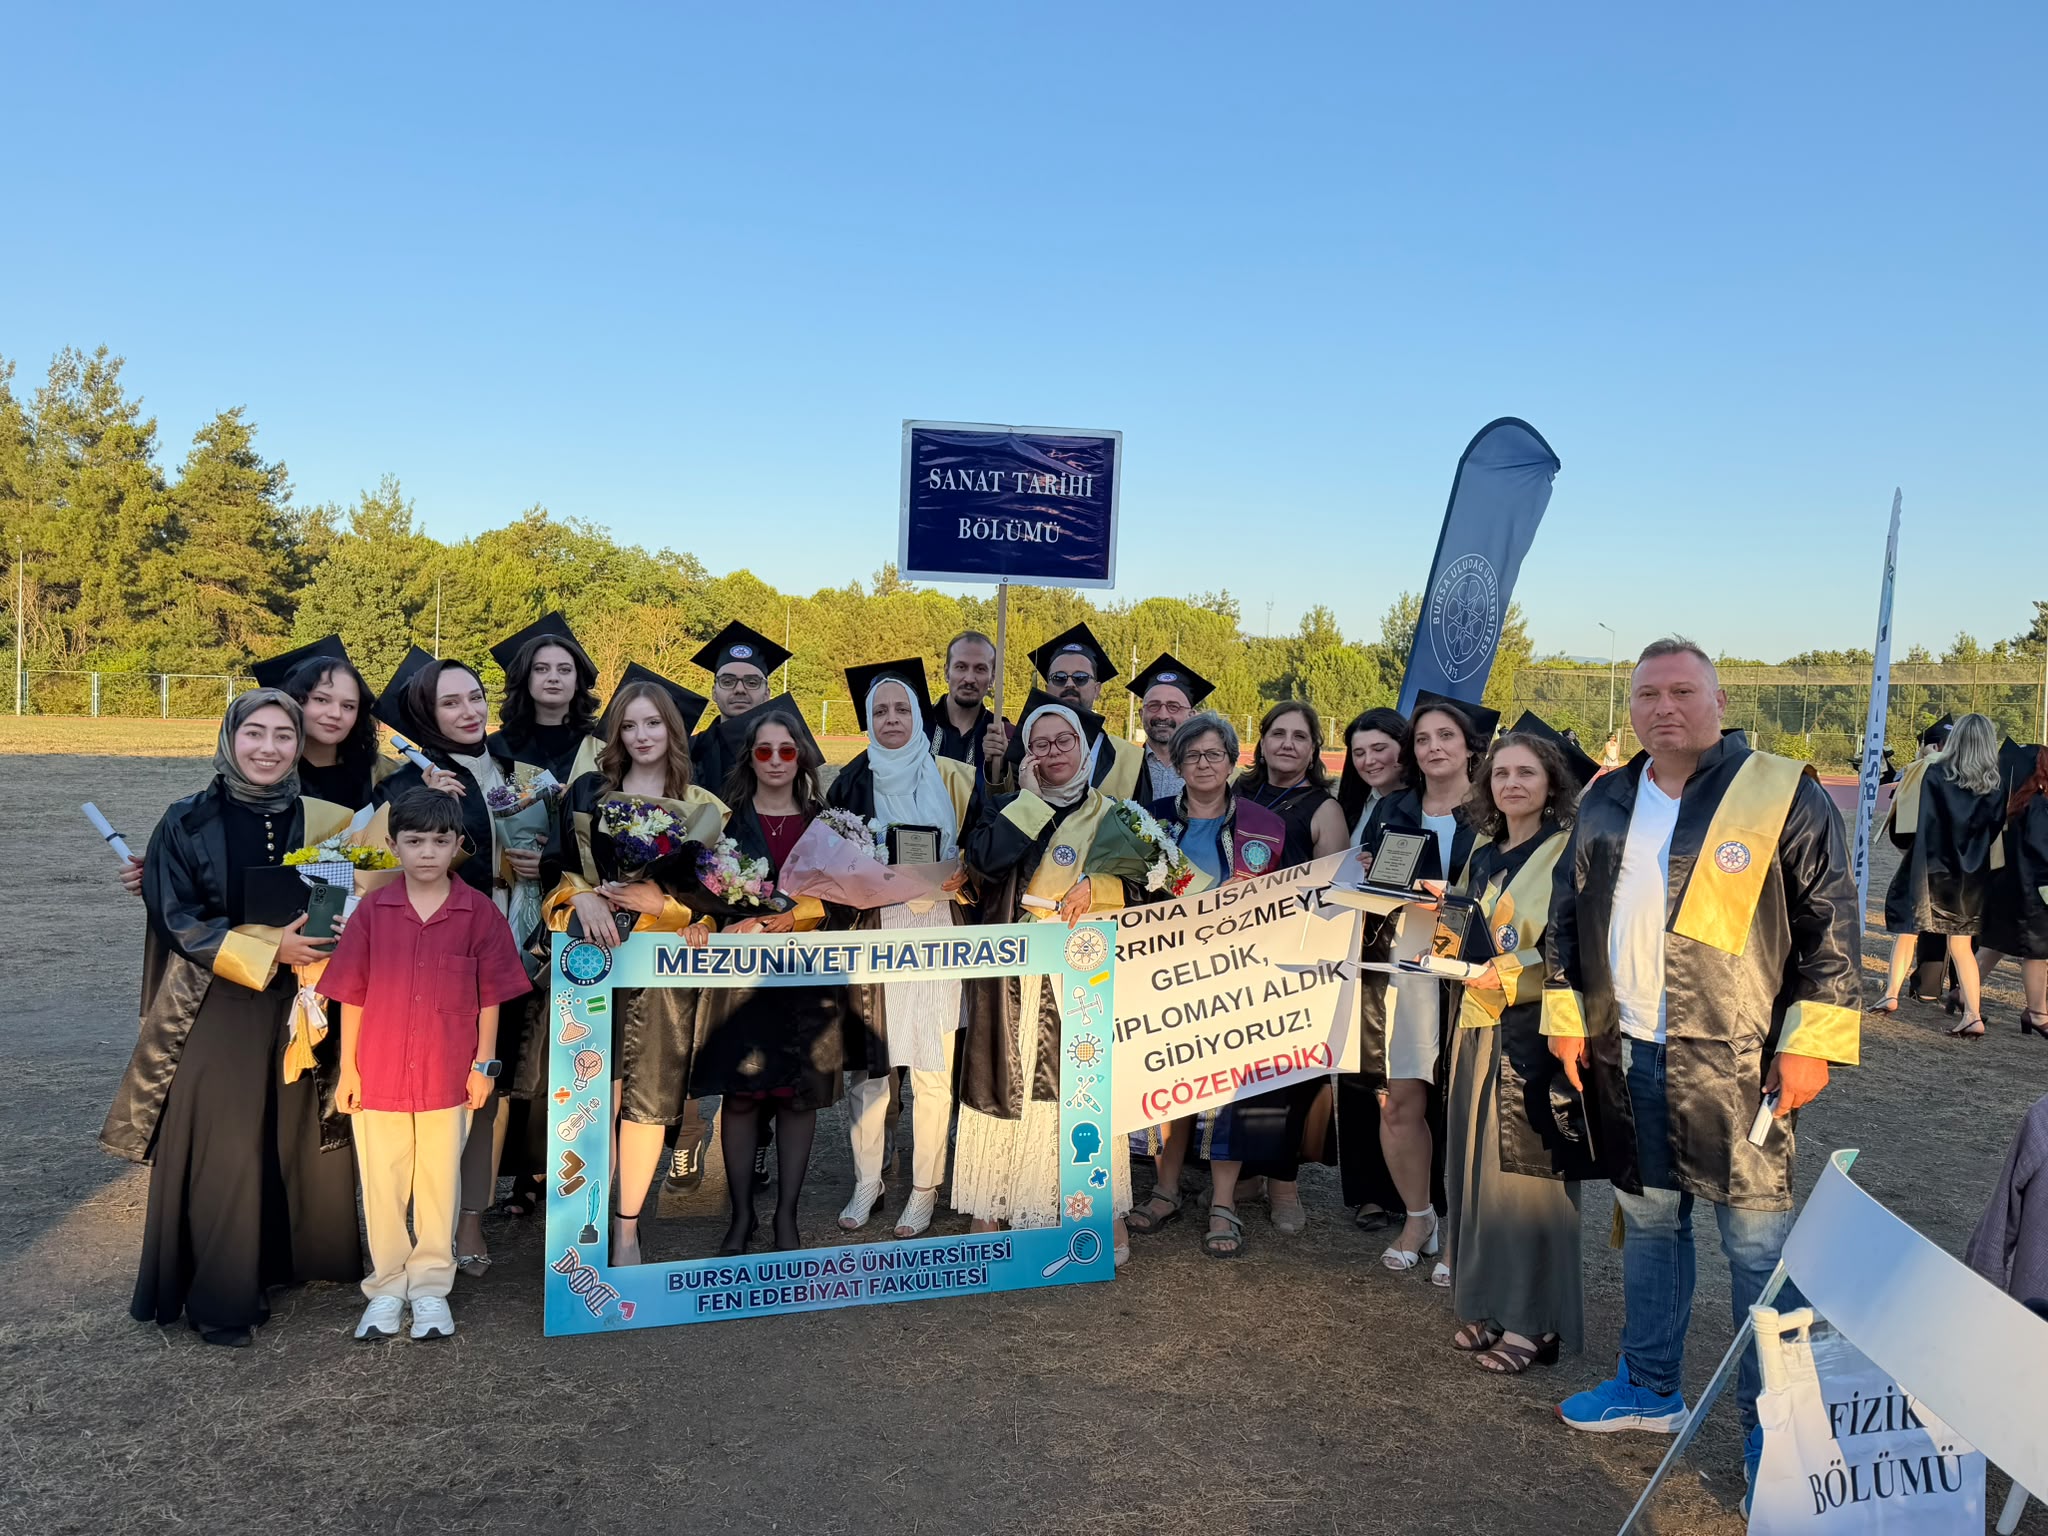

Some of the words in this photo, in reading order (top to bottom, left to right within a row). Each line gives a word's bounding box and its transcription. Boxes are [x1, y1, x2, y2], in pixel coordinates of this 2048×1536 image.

[929, 468, 1004, 492] SANAT
[1012, 472, 1093, 497] TARİHİ
[958, 517, 1061, 543] BÖLÜMÜ
[1433, 578, 1451, 624] BURSA
[1450, 559, 1484, 579] ULUDAĞ
[1444, 660, 1459, 679] 1975
[1115, 930, 1184, 962] RRINI
[1195, 886, 1334, 943] ÇÖZMEYE
[656, 939, 862, 975] MEZUNİYET
[870, 937, 1027, 971] HATIRASI
[1151, 943, 1269, 991] GELDİK,
[1111, 986, 1254, 1045] İPLOMAYI
[1263, 960, 1349, 1003] ALDIK
[1144, 1008, 1313, 1073] GİDİYORUZ!
[1141, 1042, 1333, 1120] (ÇÖZEMEDİK)
[669, 1267, 751, 1291] BURSA
[758, 1252, 856, 1282] ULUDAĞ
[862, 1238, 1011, 1272] ÜNİVERSİTESİ
[698, 1291, 742, 1312] FEN
[750, 1279, 863, 1307] EDEBİYAT
[869, 1263, 987, 1295] FAKÜLTESİ
[1827, 1385, 1928, 1440] FİZİK
[1808, 1445, 1964, 1515] BÖLÜMÜ
